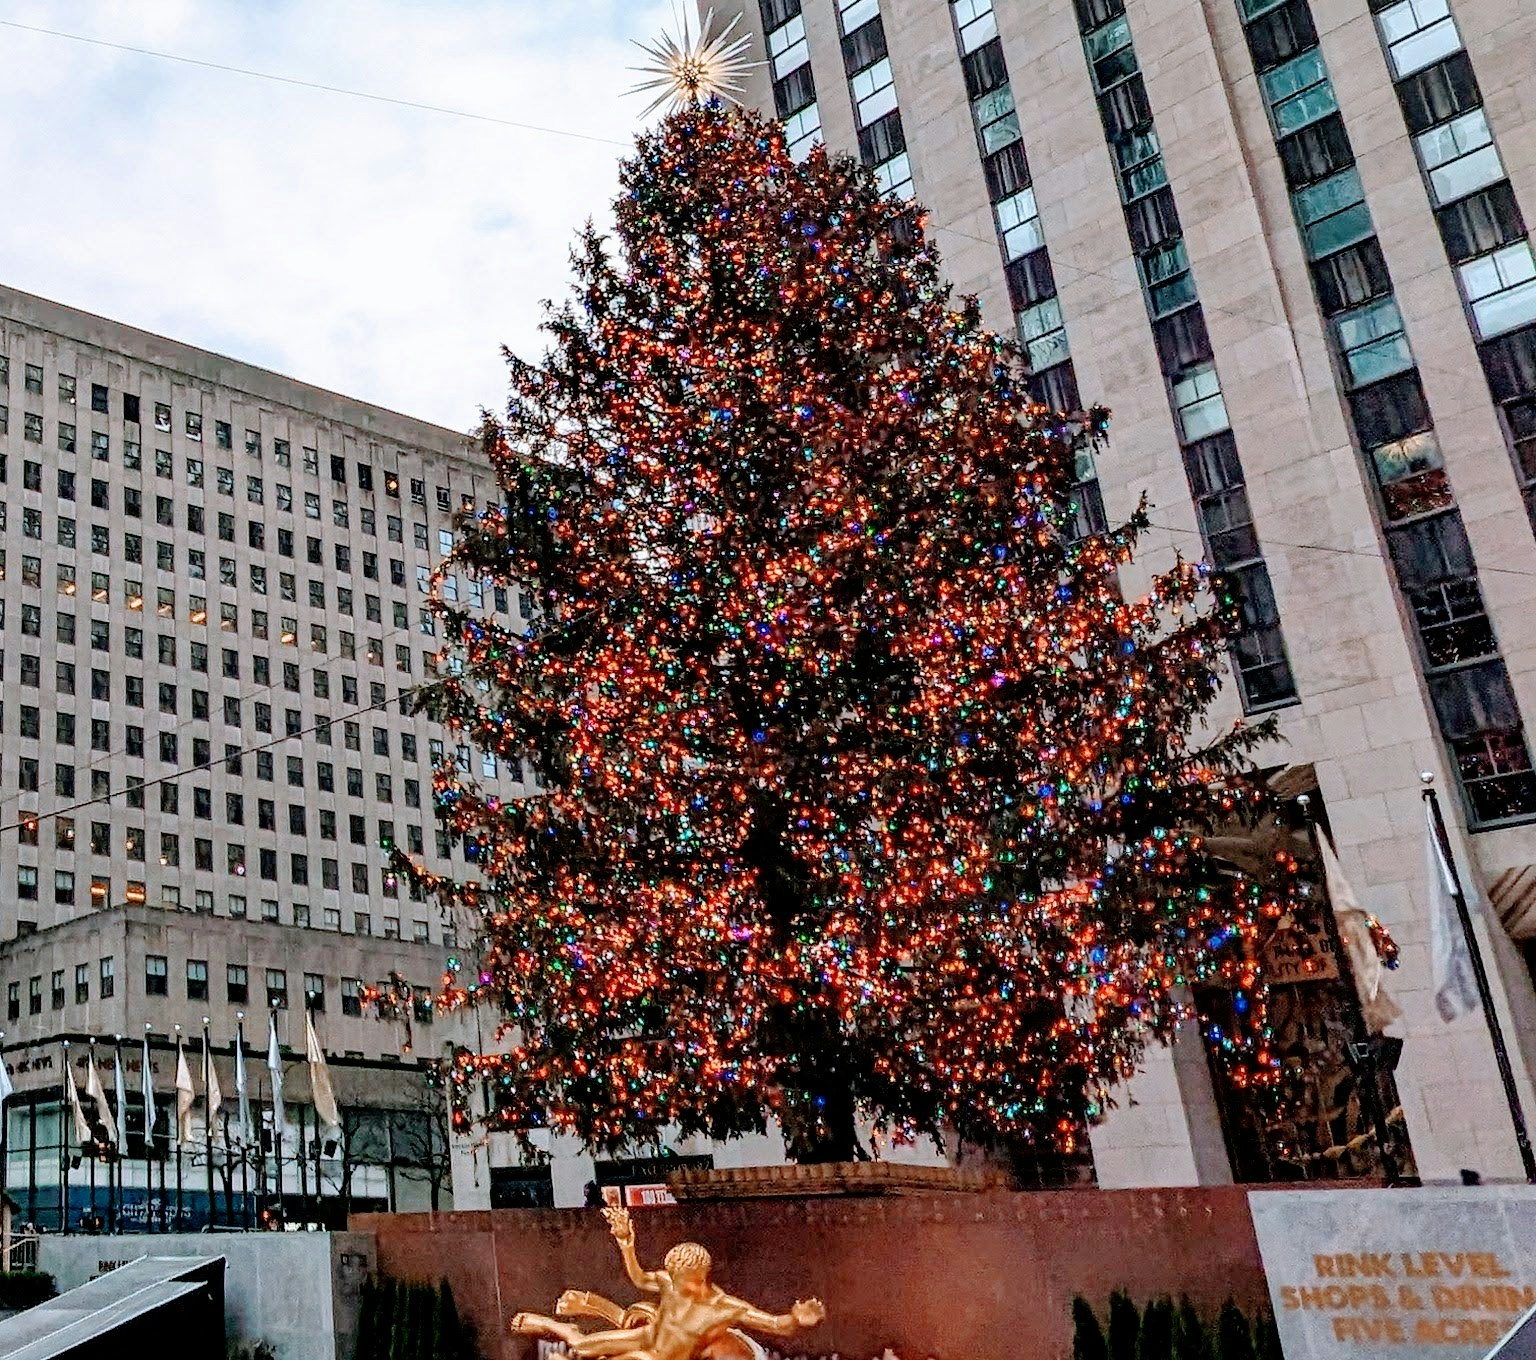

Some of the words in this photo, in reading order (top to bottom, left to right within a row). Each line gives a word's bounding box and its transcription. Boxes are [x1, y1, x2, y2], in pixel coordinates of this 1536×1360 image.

[1314, 1251, 1395, 1278] RINK
[1401, 1251, 1511, 1278] LEVEL
[1280, 1285, 1391, 1310] SHOPS
[1332, 1317, 1406, 1343] FIVE
